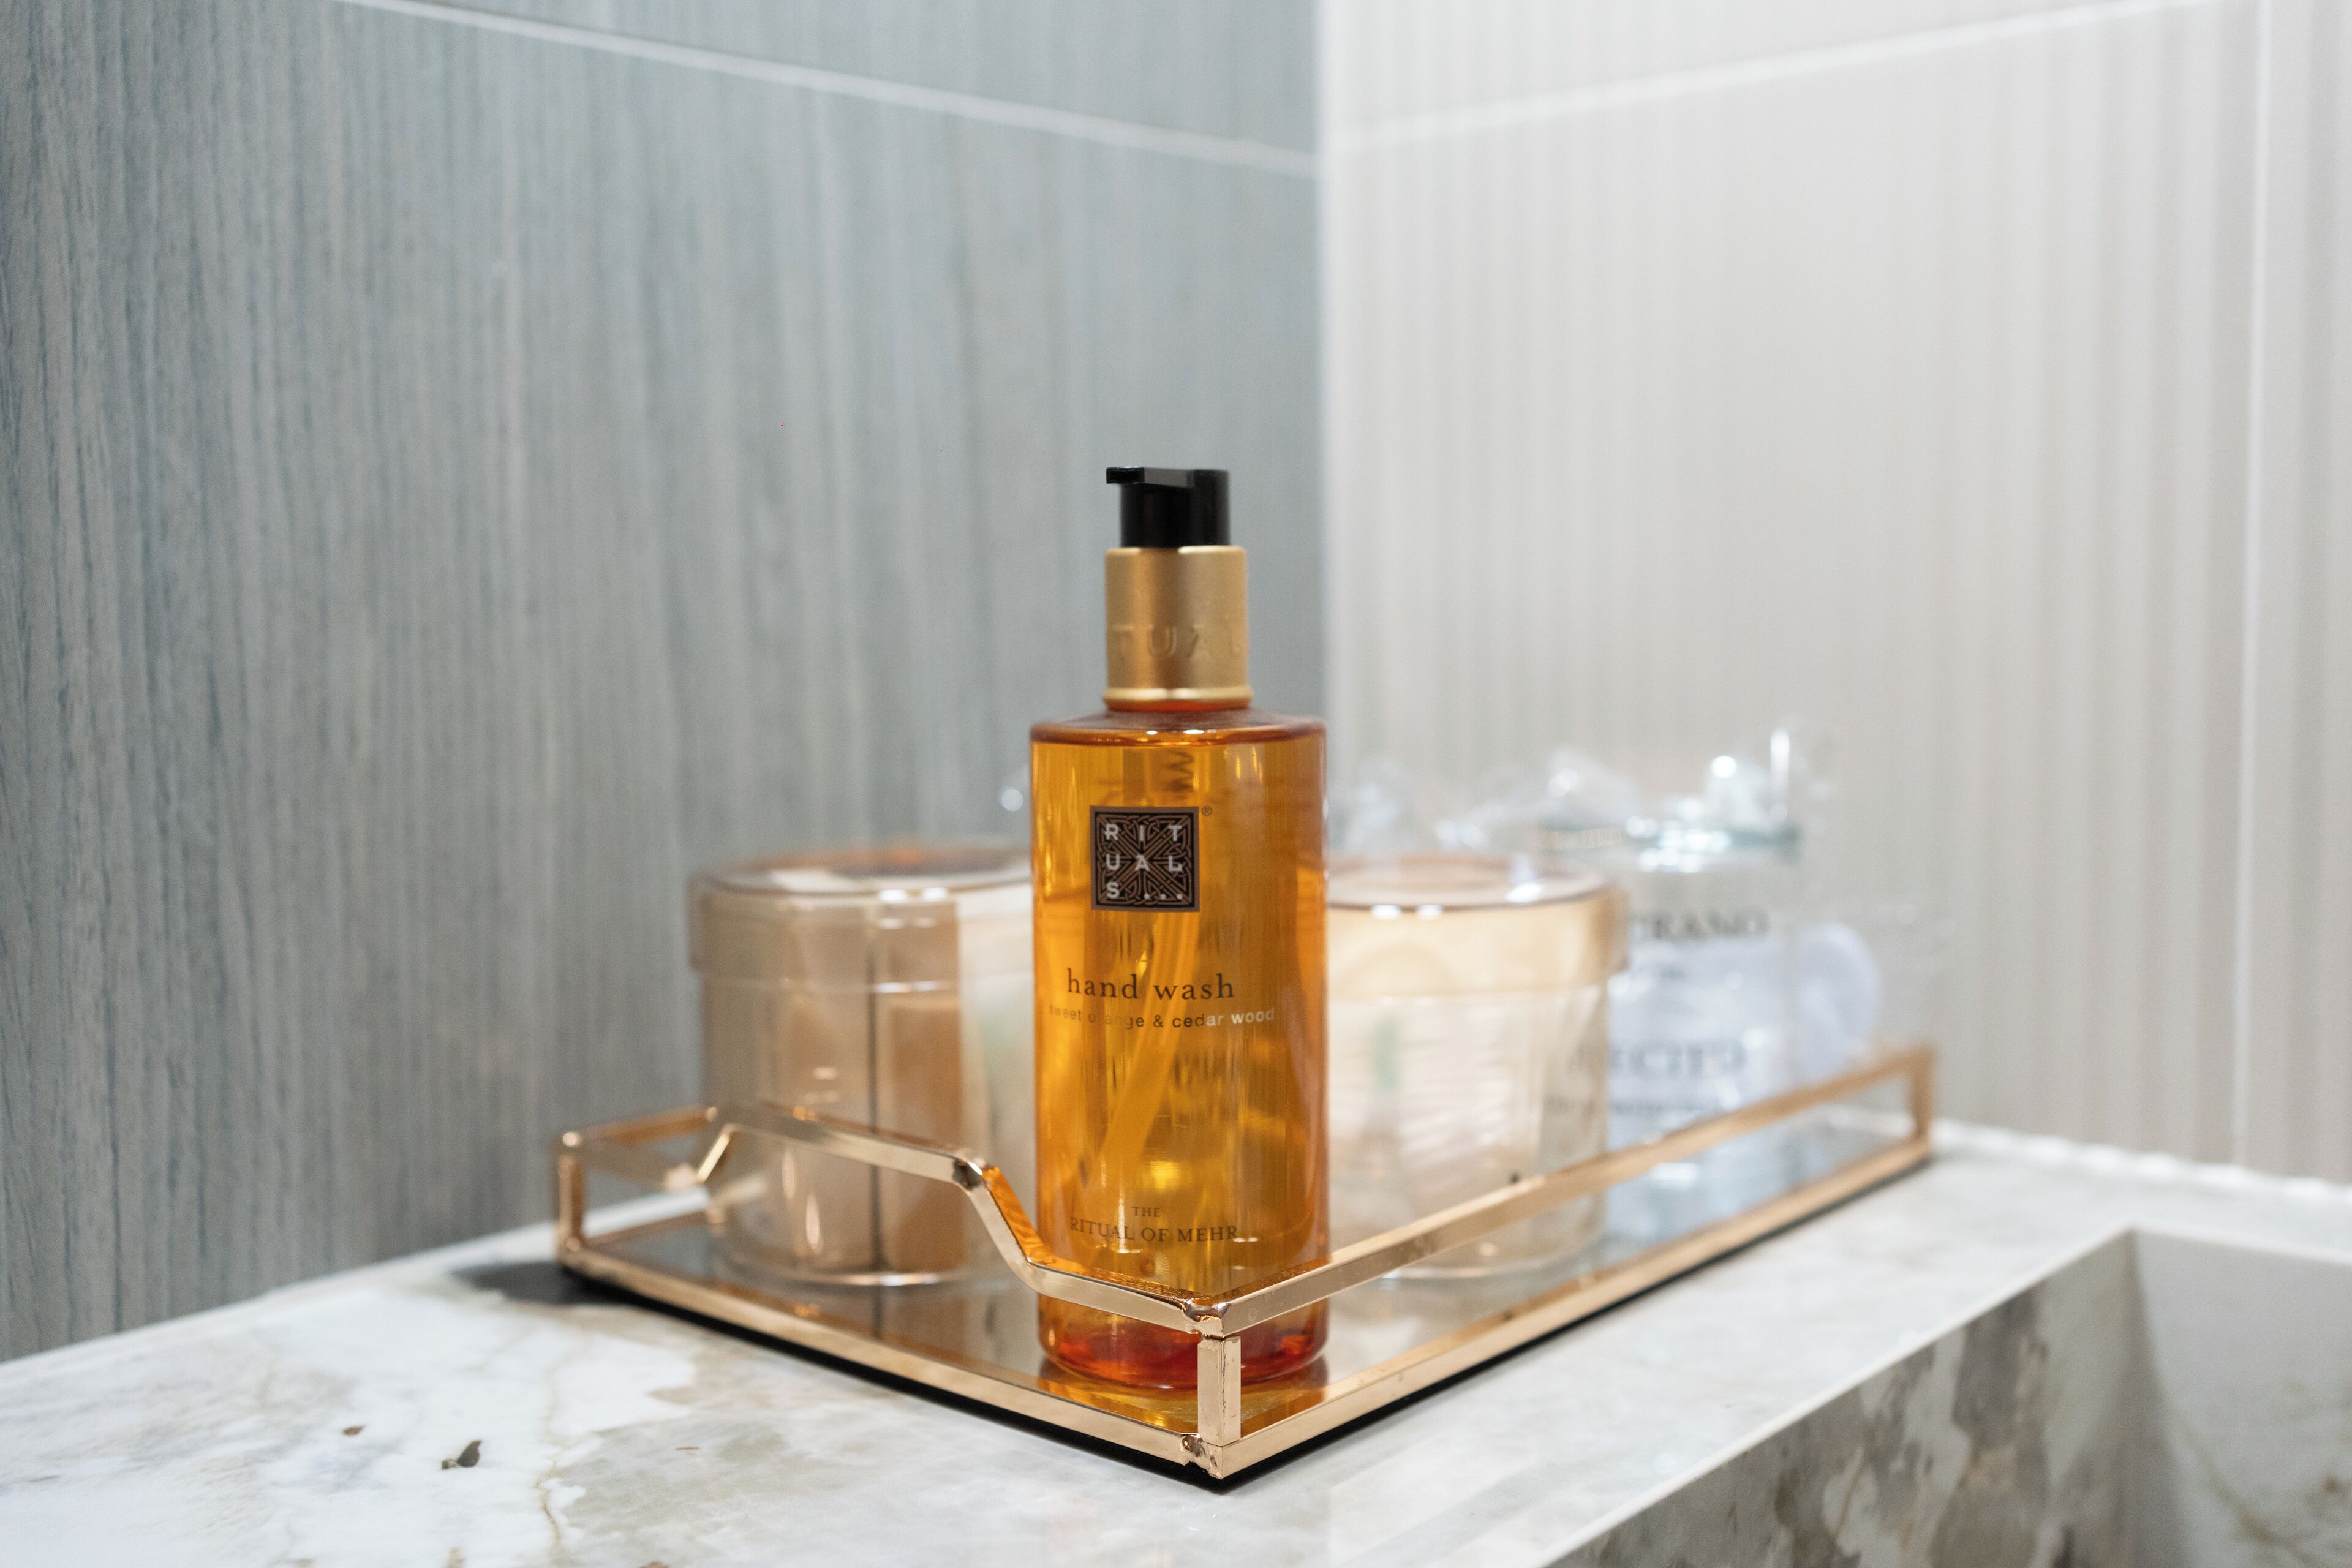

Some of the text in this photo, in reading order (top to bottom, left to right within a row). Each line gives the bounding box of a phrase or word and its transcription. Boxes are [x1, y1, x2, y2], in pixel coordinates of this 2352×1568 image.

[1067, 967, 1236, 1000] hand wash
[1153, 1014, 1164, 1028] &
[1172, 1012, 1224, 1028] cedar
[1231, 1006, 1275, 1025] wood
[1131, 1206, 1161, 1218] THE
[1069, 1216, 1240, 1243] RITUAL OF MEHR
